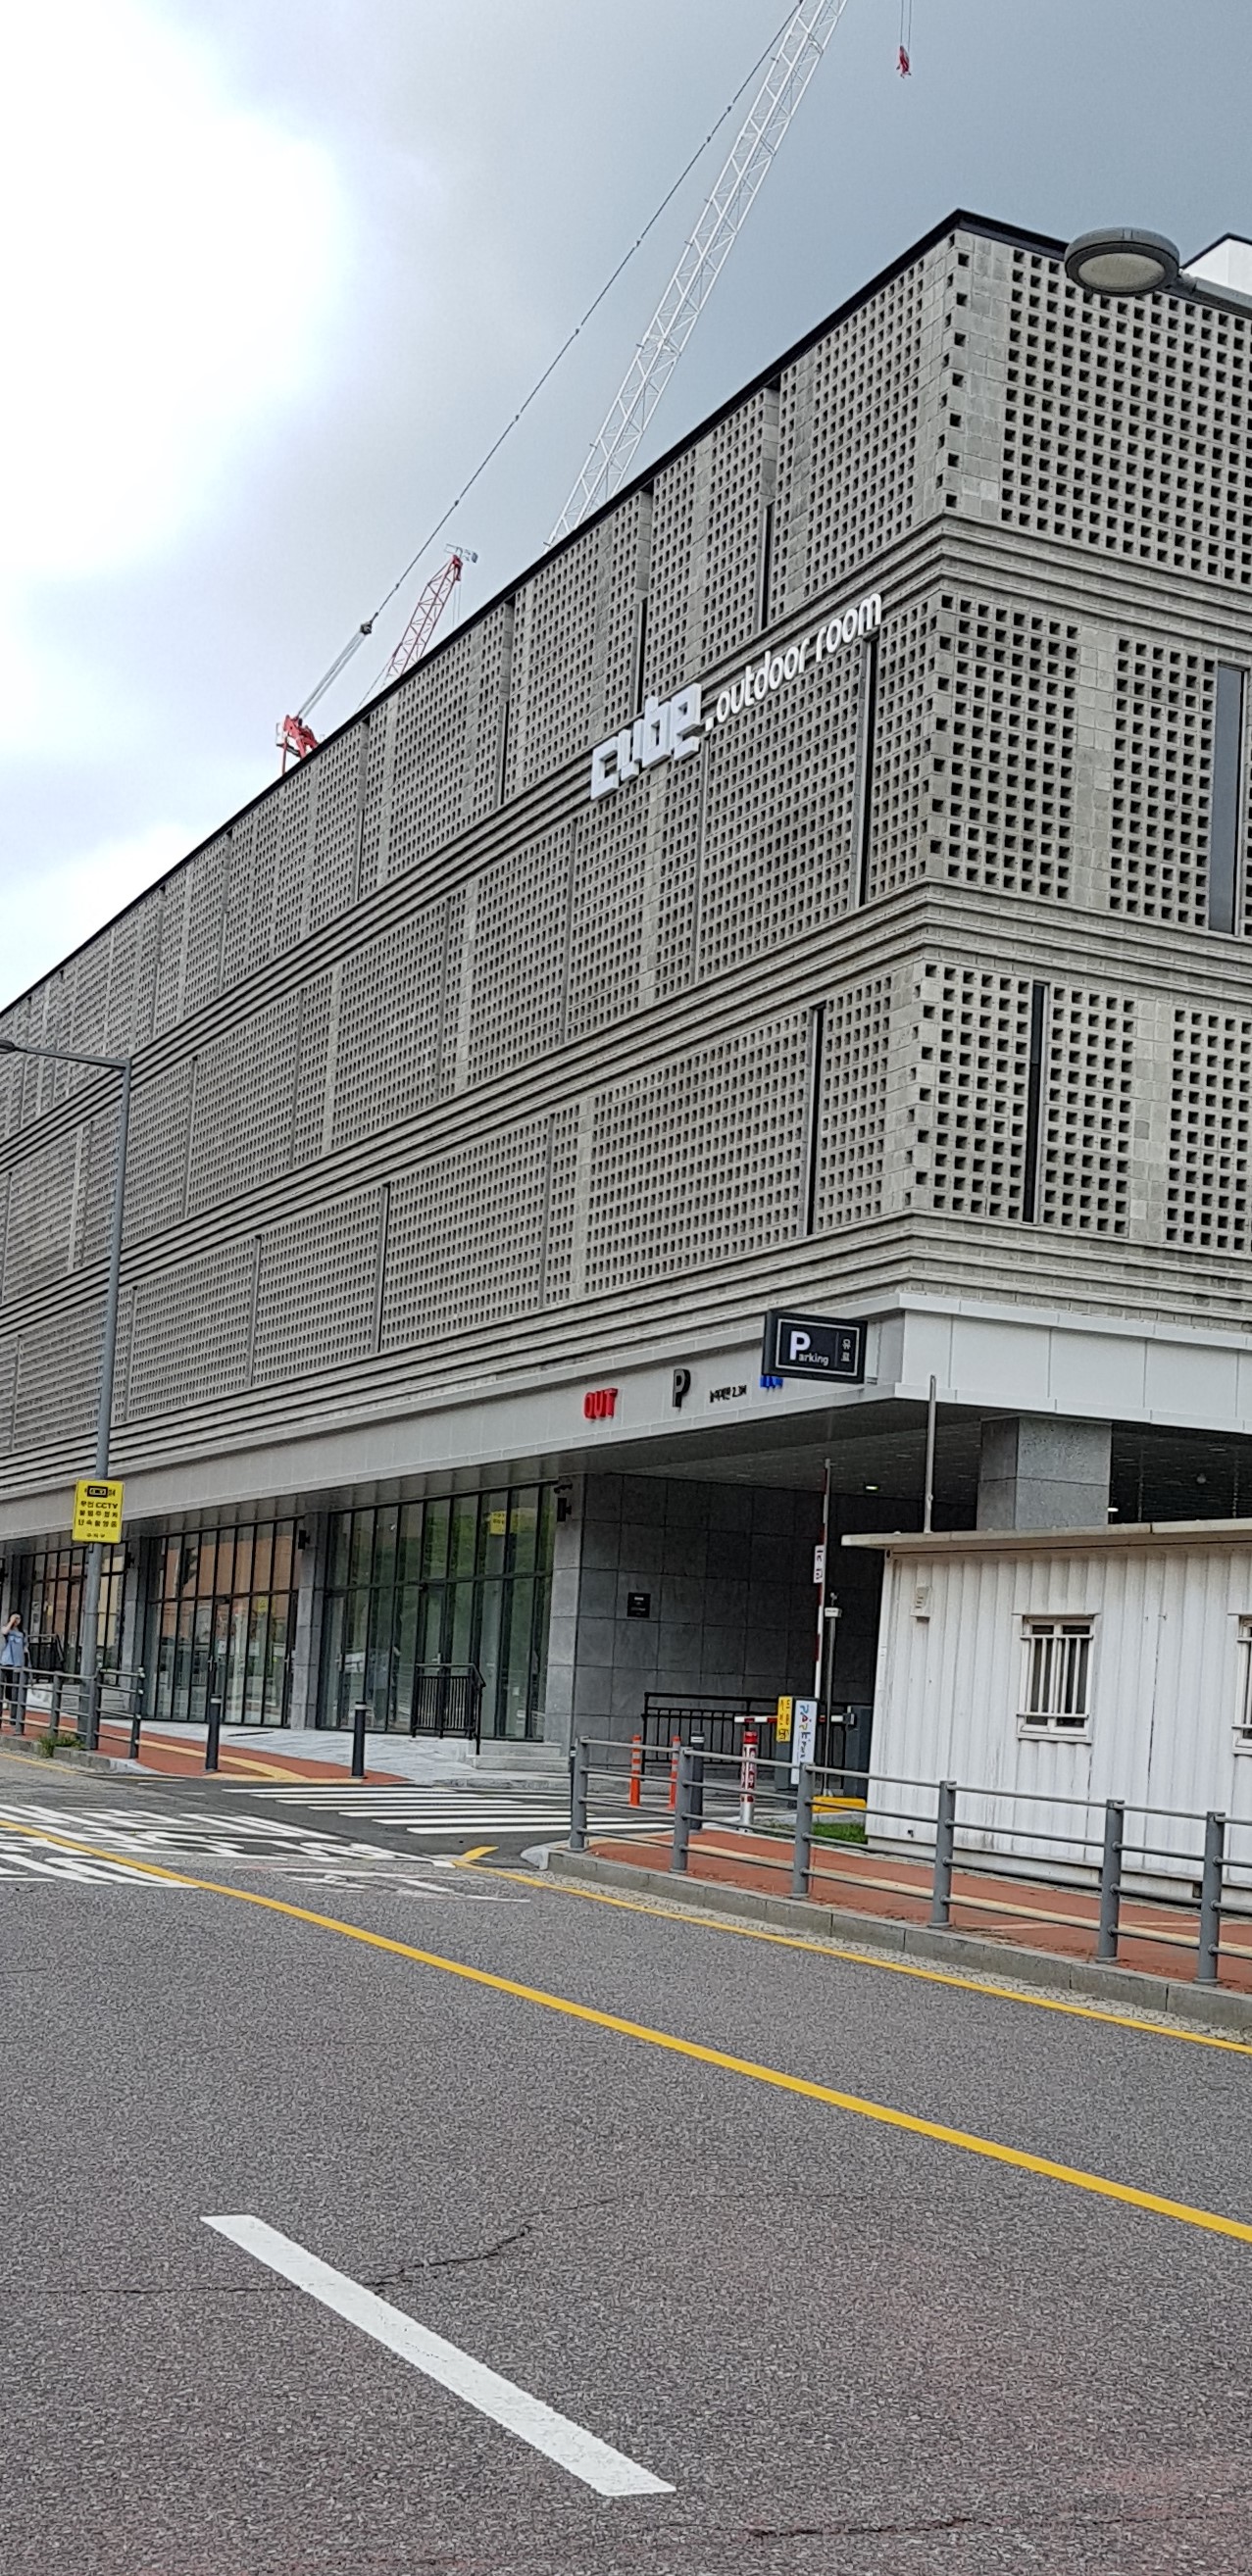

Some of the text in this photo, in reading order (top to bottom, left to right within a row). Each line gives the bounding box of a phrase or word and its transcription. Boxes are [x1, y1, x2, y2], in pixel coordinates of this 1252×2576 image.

[816, 593, 882, 663] room
[582, 1387, 619, 1420] OUT
[672, 1368, 691, 1409] P
